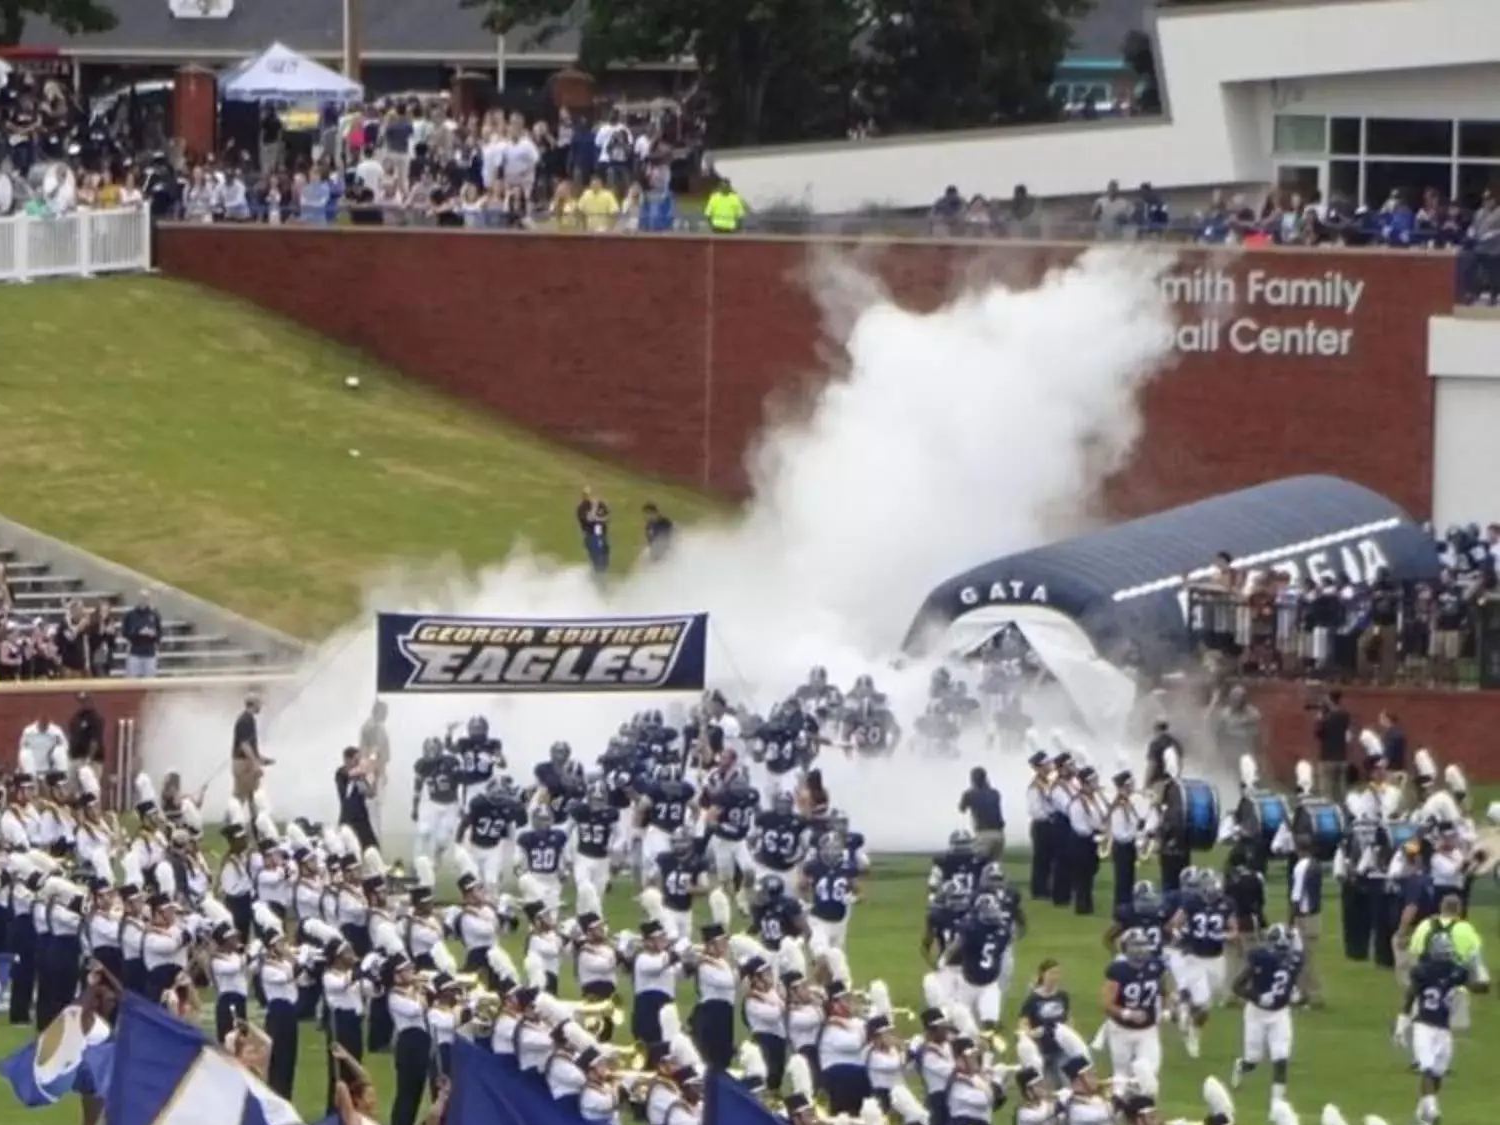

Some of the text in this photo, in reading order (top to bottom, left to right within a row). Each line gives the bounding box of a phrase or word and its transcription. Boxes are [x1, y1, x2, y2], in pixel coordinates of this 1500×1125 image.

[1159, 269, 1366, 314] mith Family
[1229, 316, 1355, 356] Center
[959, 578, 1050, 606] GATA
[418, 622, 682, 645] GEORGIA SOUTHERN
[406, 642, 673, 684] EAGLES
[655, 802, 683, 821] 72
[764, 829, 796, 855] 63
[530, 849, 556, 870] 20
[816, 876, 849, 902] 46
[980, 942, 997, 969] 5
[1123, 980, 1158, 1008] 97
